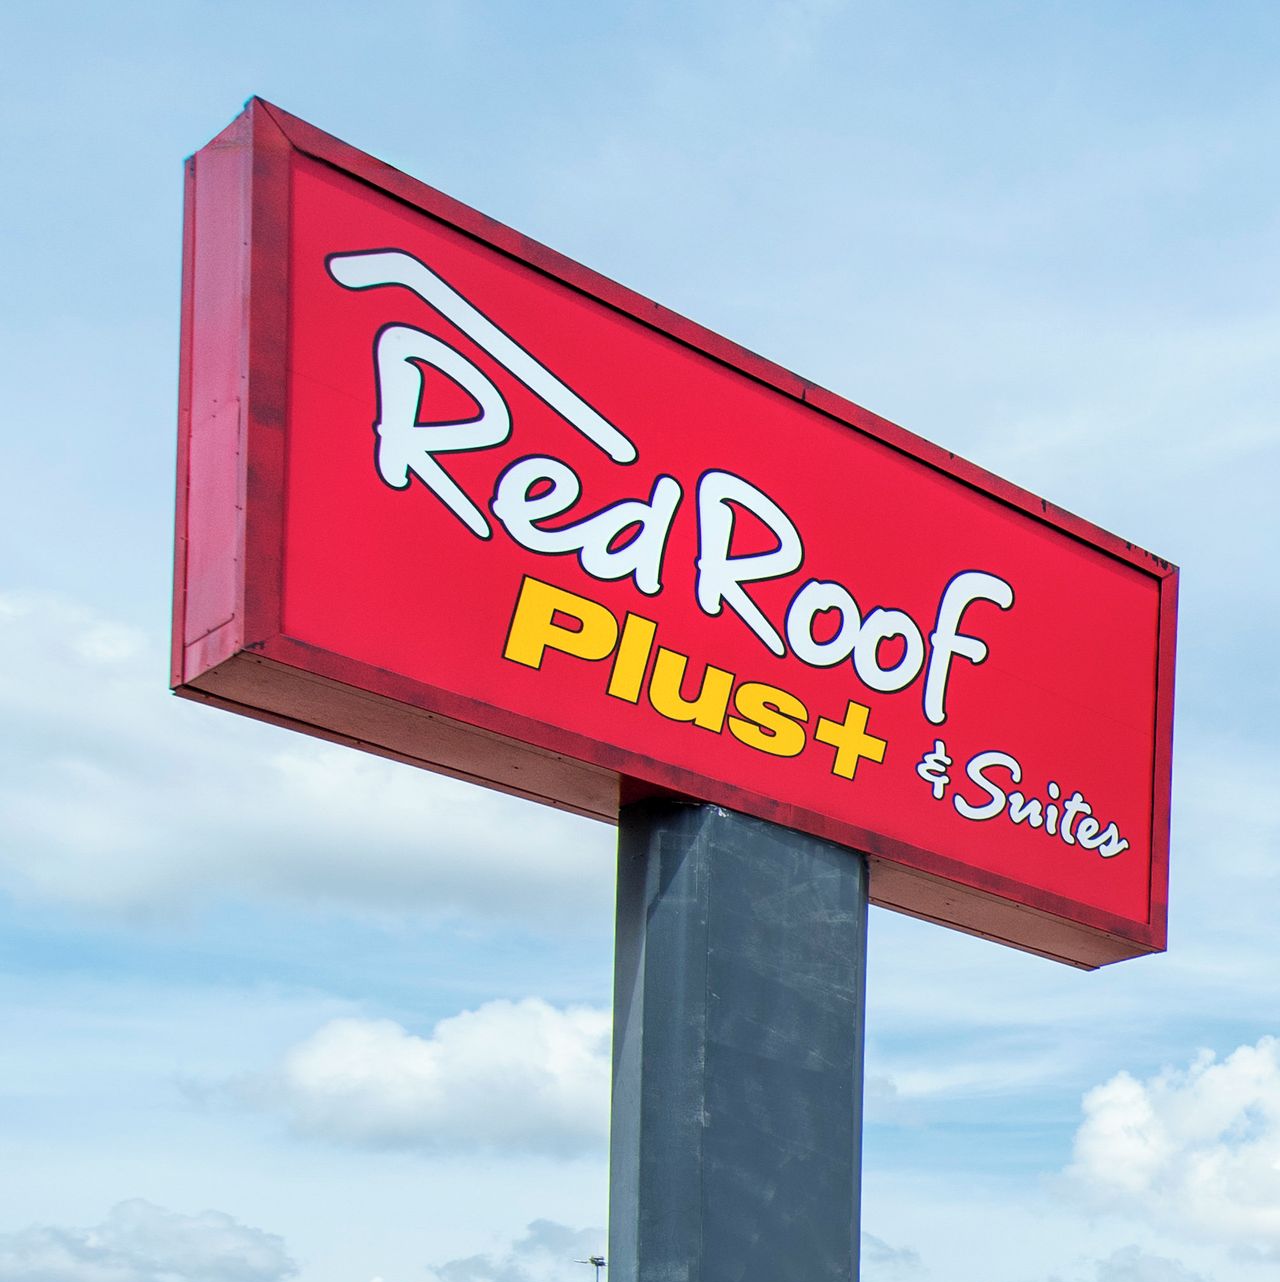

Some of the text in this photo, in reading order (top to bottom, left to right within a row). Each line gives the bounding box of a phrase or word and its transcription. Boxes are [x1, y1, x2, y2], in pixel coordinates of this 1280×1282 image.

[374, 322, 1013, 724] Red Roof
[503, 574, 888, 781] Plus+
[917, 739, 1129, 860] & Suites
